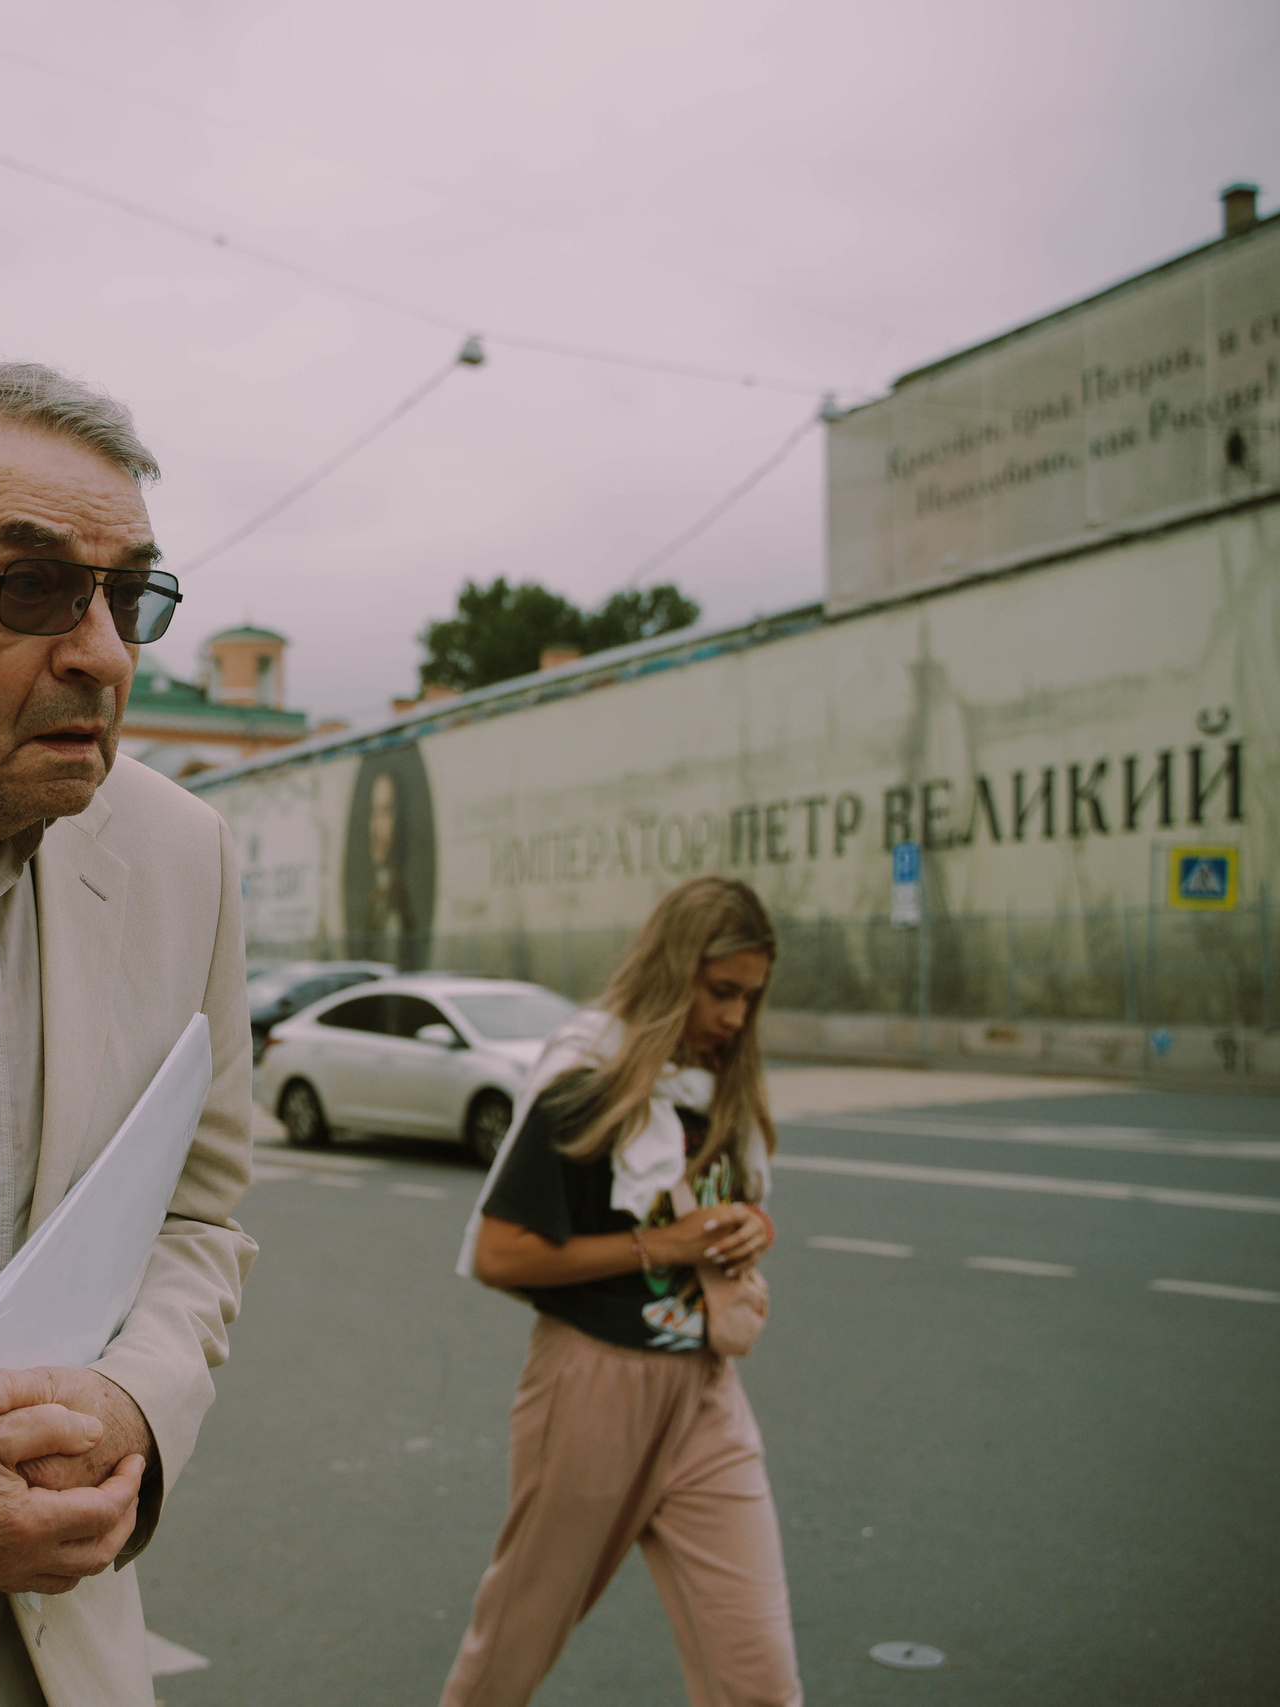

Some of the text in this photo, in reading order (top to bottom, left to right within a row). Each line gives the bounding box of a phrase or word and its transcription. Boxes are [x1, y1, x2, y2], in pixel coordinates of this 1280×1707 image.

[489, 706, 1243, 887] ИМПЕРАТОР ПЕТР ВЕЛИКИЙ
